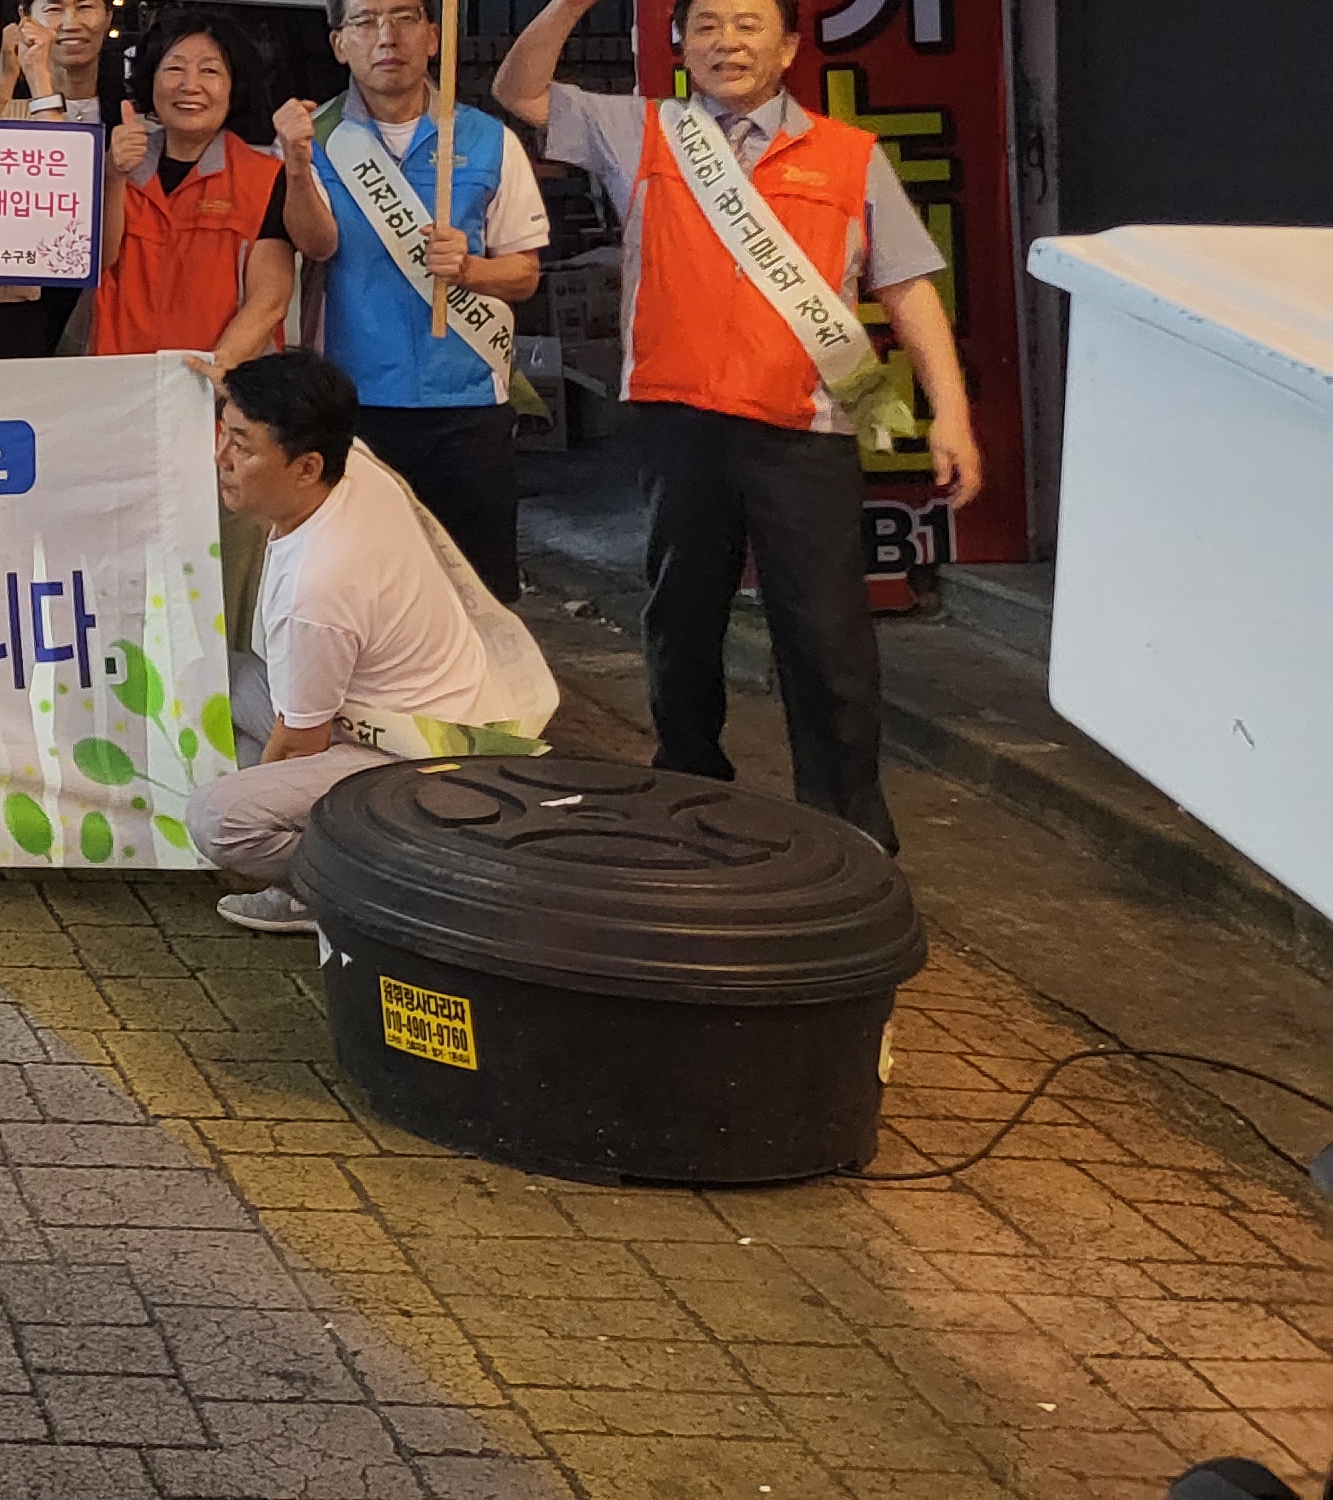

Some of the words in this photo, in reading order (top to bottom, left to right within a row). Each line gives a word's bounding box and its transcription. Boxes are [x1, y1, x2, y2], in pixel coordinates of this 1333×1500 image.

[352, 157, 418, 239] 건전한
[675, 113, 727, 188] 건전한
[714, 186, 806, 293] 광고문화
[794, 293, 853, 349] 정착
